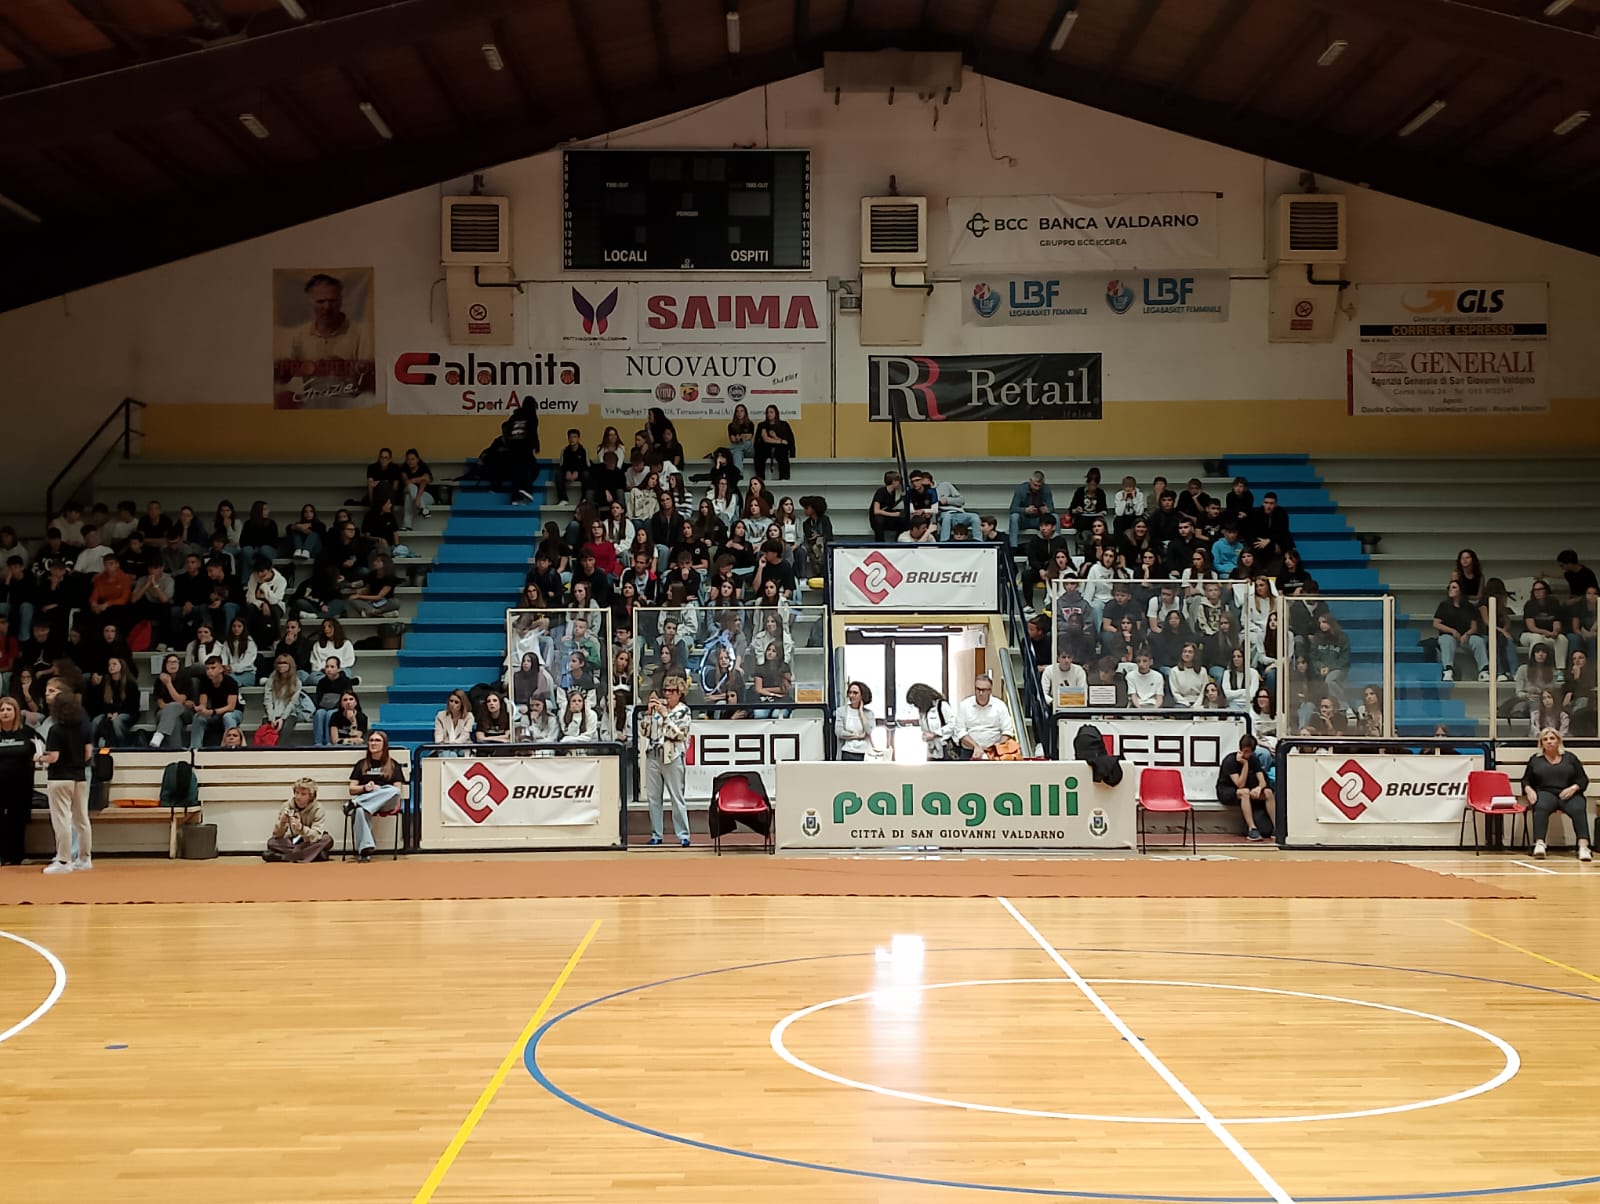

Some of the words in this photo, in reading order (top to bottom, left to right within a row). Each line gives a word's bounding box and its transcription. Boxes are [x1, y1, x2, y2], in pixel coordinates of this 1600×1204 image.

[994, 218, 1028, 231] BCC
[1039, 217, 1098, 230] BANCA
[1104, 214, 1199, 229] VALDARNO
[1039, 239, 1076, 247] GRUPPO
[604, 250, 648, 262] LOCALI
[730, 250, 769, 262] OSPITI
[1009, 280, 1060, 308] LBF
[1143, 277, 1195, 306] LBF
[1456, 289, 1505, 313] GLS
[647, 295, 819, 330] SAIMA
[1391, 325, 1451, 336] CORRIERE
[1454, 324, 1515, 335] ESPRESSO
[626, 355, 777, 377] NUOVAUTO
[1410, 351, 1536, 374] GENERALI
[967, 367, 1092, 406] Retail
[1371, 376, 1402, 387] Agenzia
[1404, 376, 1438, 385] Generale
[1449, 376, 1465, 385] San
[1467, 376, 1500, 385] Giovanni
[1502, 375, 1536, 385] Valdarno
[462, 390, 503, 413] Sport
[505, 390, 578, 413] Ademy
[905, 571, 978, 584] BRUSCHI
[512, 785, 595, 799] BRUSCHI
[1385, 782, 1469, 796] BRUSCHI
[832, 776, 1079, 826] palagalli
[850, 827, 885, 839] CITTÀ
[892, 829, 904, 838] DI
[911, 829, 933, 838] SAN
[939, 829, 996, 839] GIOVANNI
[1002, 830, 1065, 839] VALDARNO
